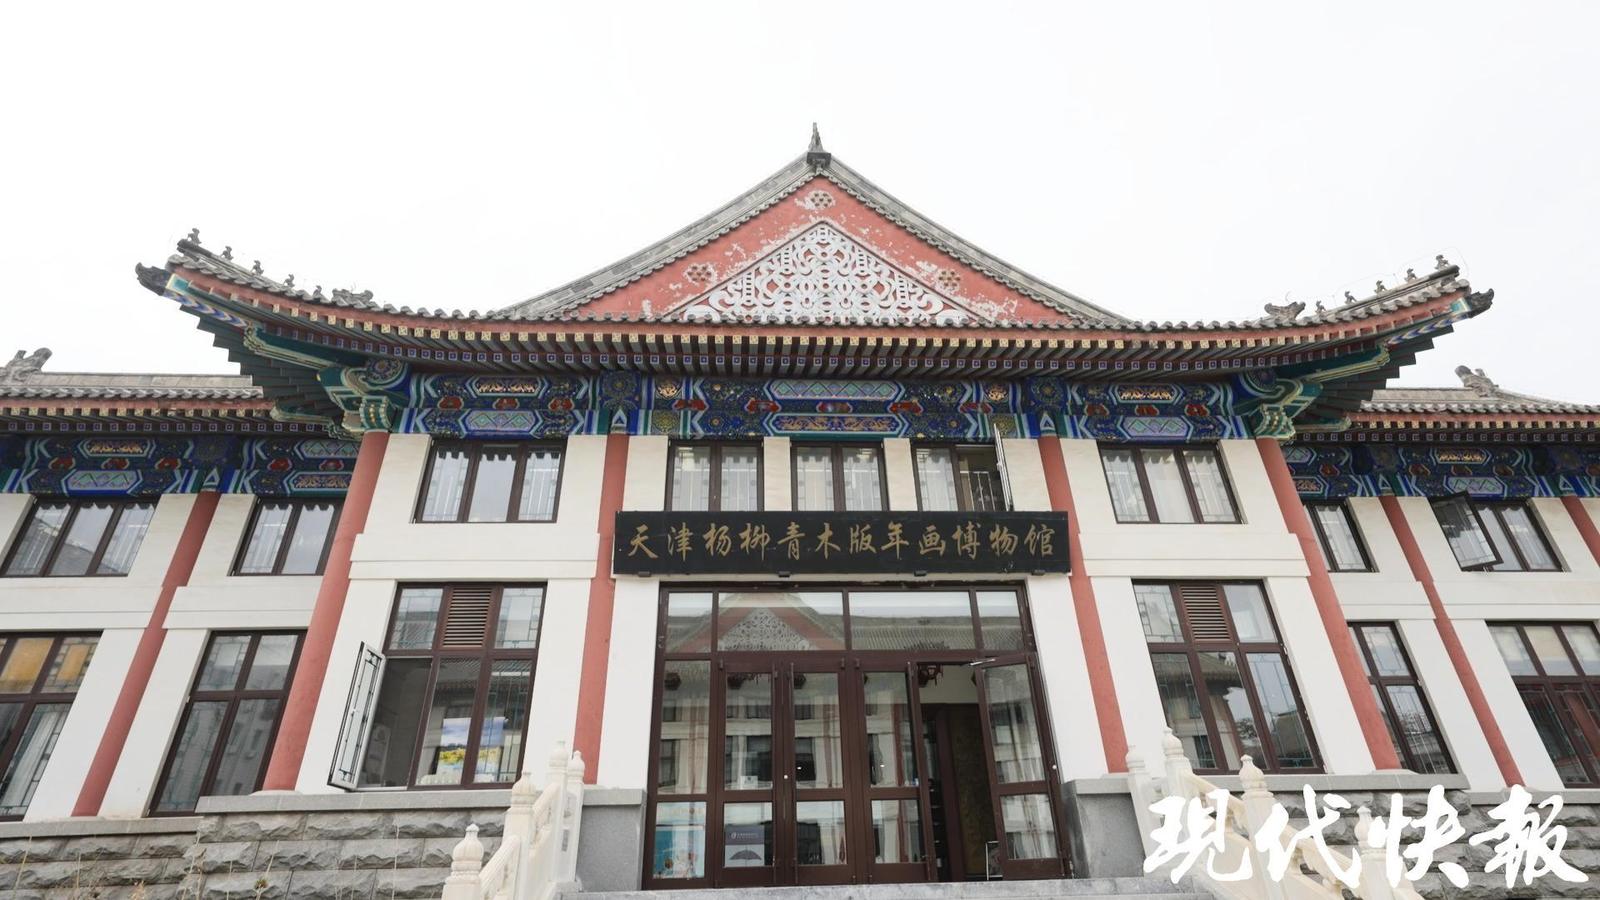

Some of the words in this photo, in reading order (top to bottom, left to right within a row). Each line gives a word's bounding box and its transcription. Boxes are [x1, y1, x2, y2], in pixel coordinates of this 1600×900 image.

[628, 520, 1055, 562] 天津杨柳青木版年画博物馆
